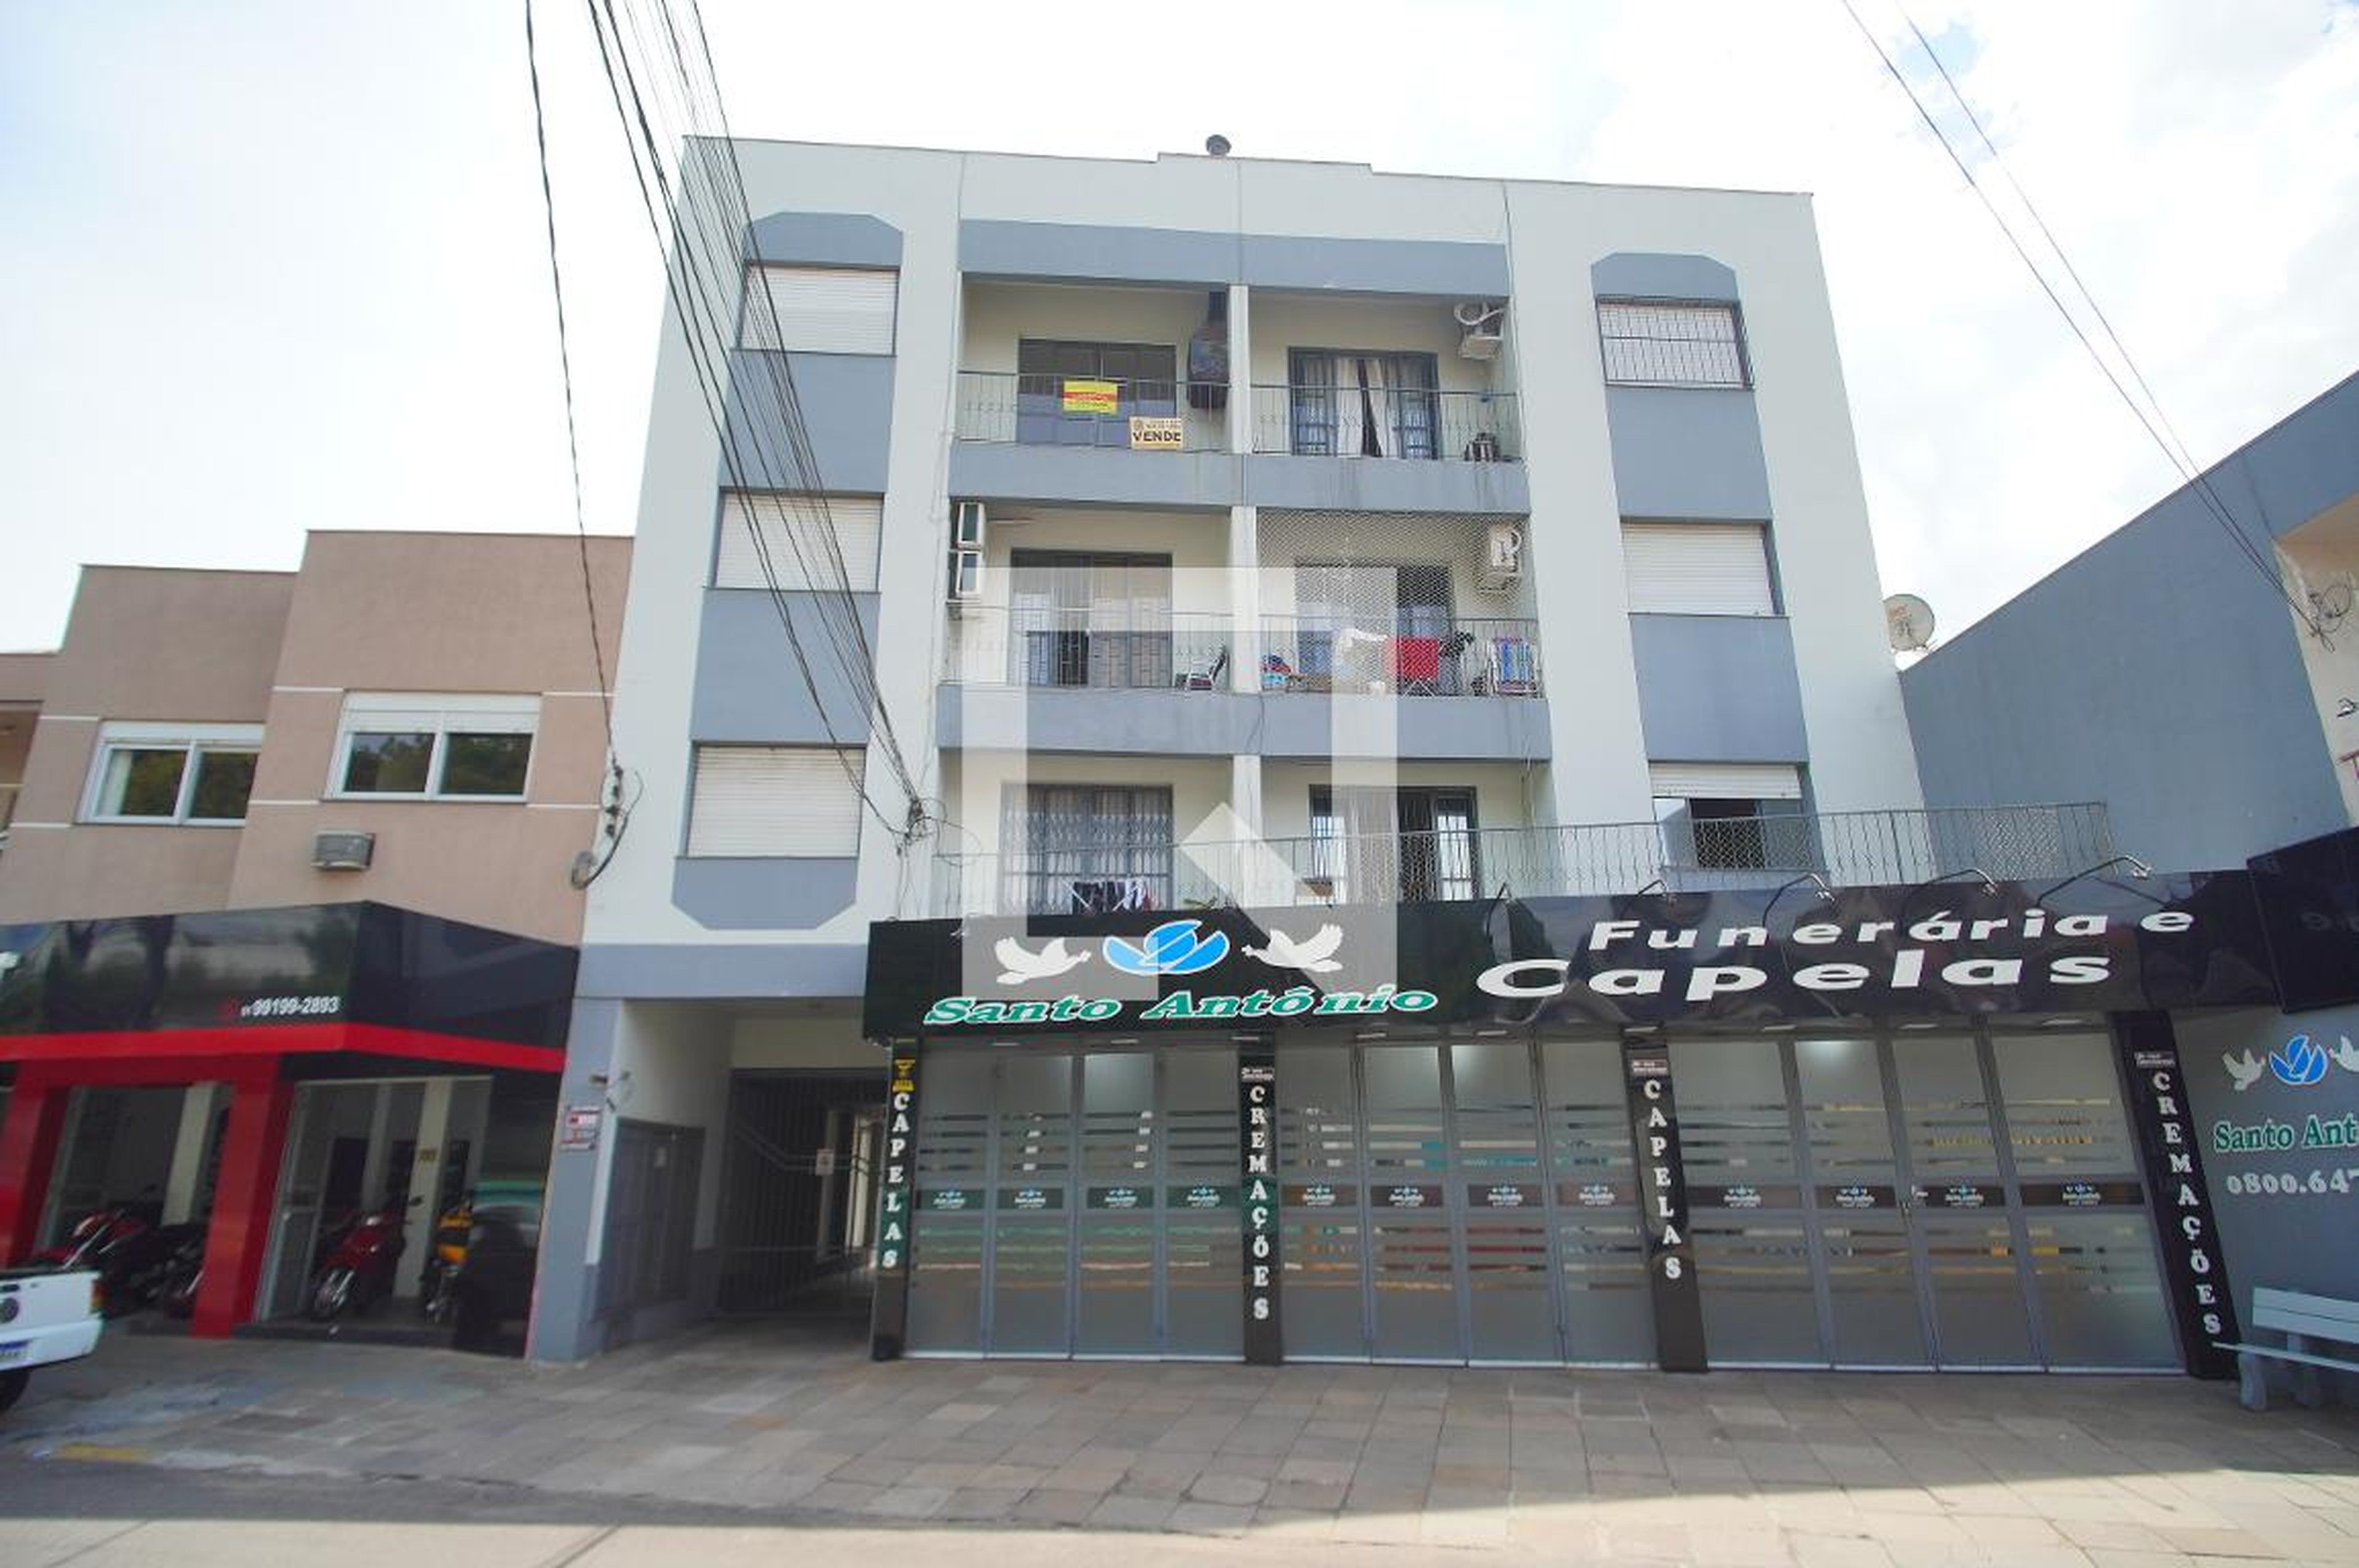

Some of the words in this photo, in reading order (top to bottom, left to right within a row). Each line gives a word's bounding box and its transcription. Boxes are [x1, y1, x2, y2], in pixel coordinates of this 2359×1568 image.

[1133, 430, 1181, 442] VENDE
[1589, 910, 2109, 951] Funerária
[2140, 907, 2196, 933] e
[1476, 950, 2111, 1002] Capelas
[251, 996, 340, 1016] 99199-2893
[923, 996, 1122, 1027] Santo
[1140, 985, 1439, 1020] Antônio
[2213, 1120, 2295, 1153] Santo
[2302, 1112, 2359, 1149] Ant
[882, 1093, 910, 1268] CAPELAS
[1248, 1085, 1269, 1320] CREMAÇÕES
[1644, 1079, 1682, 1279] CAPELAS
[2152, 1072, 2221, 1335] CREMAÇÕES
